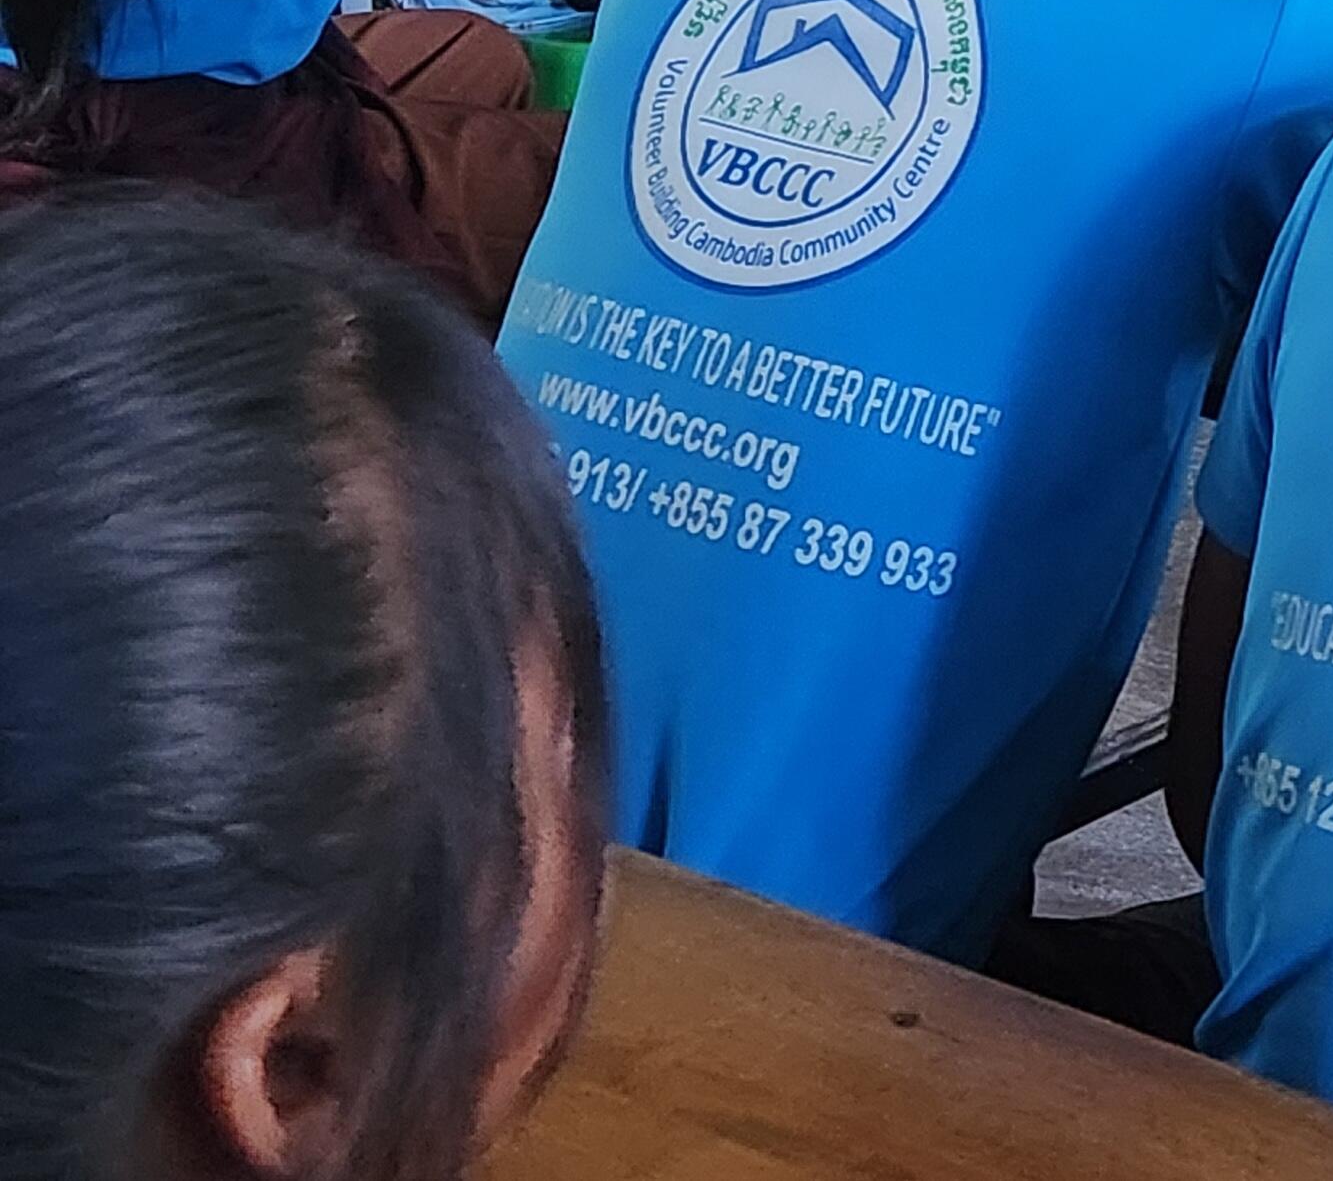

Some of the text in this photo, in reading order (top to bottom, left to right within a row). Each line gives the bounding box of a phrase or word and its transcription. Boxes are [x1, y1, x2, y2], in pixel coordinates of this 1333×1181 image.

[643, 58, 951, 268] Volunteer Building Cambodia Community Centre
[698, 138, 837, 209] VBCCC
[588, 299, 646, 360] THE
[636, 314, 698, 375] KEY
[698, 328, 733, 386] TO
[724, 341, 751, 392] A
[746, 345, 866, 426] BETTER
[537, 371, 800, 491] www.vbccc.org
[568, 448, 958, 597] 913/ +855 87 339 933
